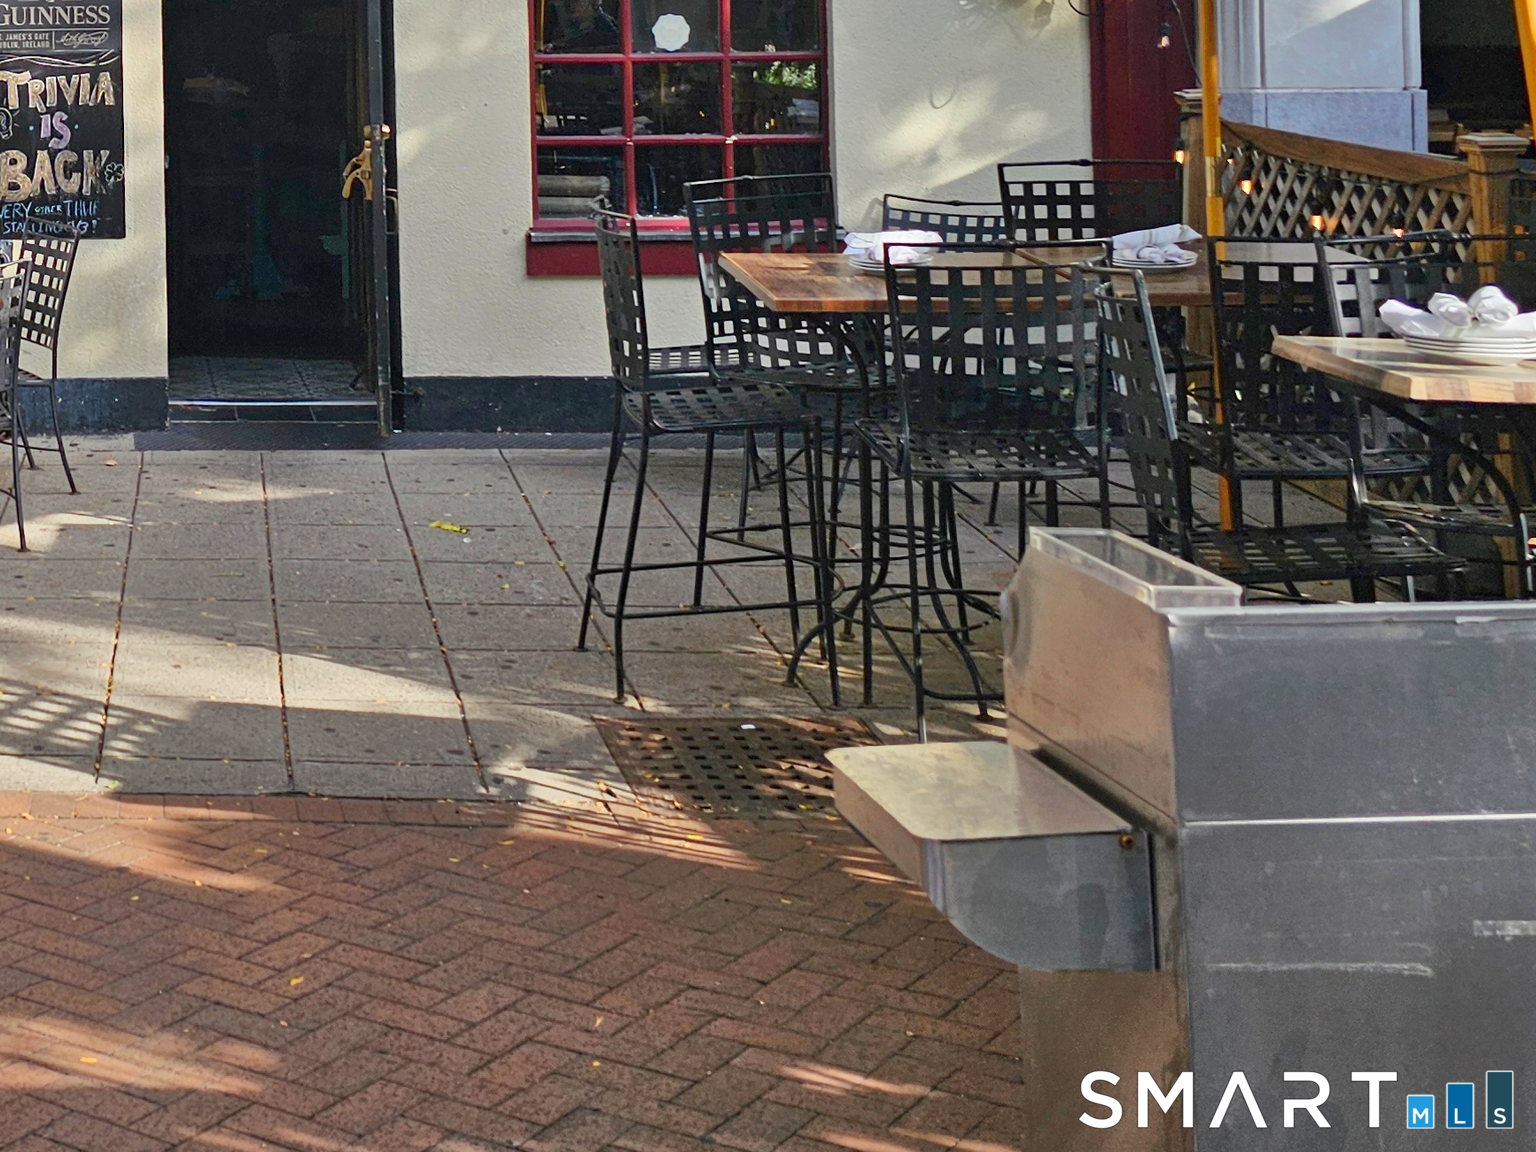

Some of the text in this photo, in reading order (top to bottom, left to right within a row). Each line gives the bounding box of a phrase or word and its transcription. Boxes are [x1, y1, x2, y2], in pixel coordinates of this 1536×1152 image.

[5, 32, 32, 41] JAMES'S
[34, 32, 49, 40] GATE
[22, 41, 50, 49] IRELAND
[40, 111, 72, 149] IS
